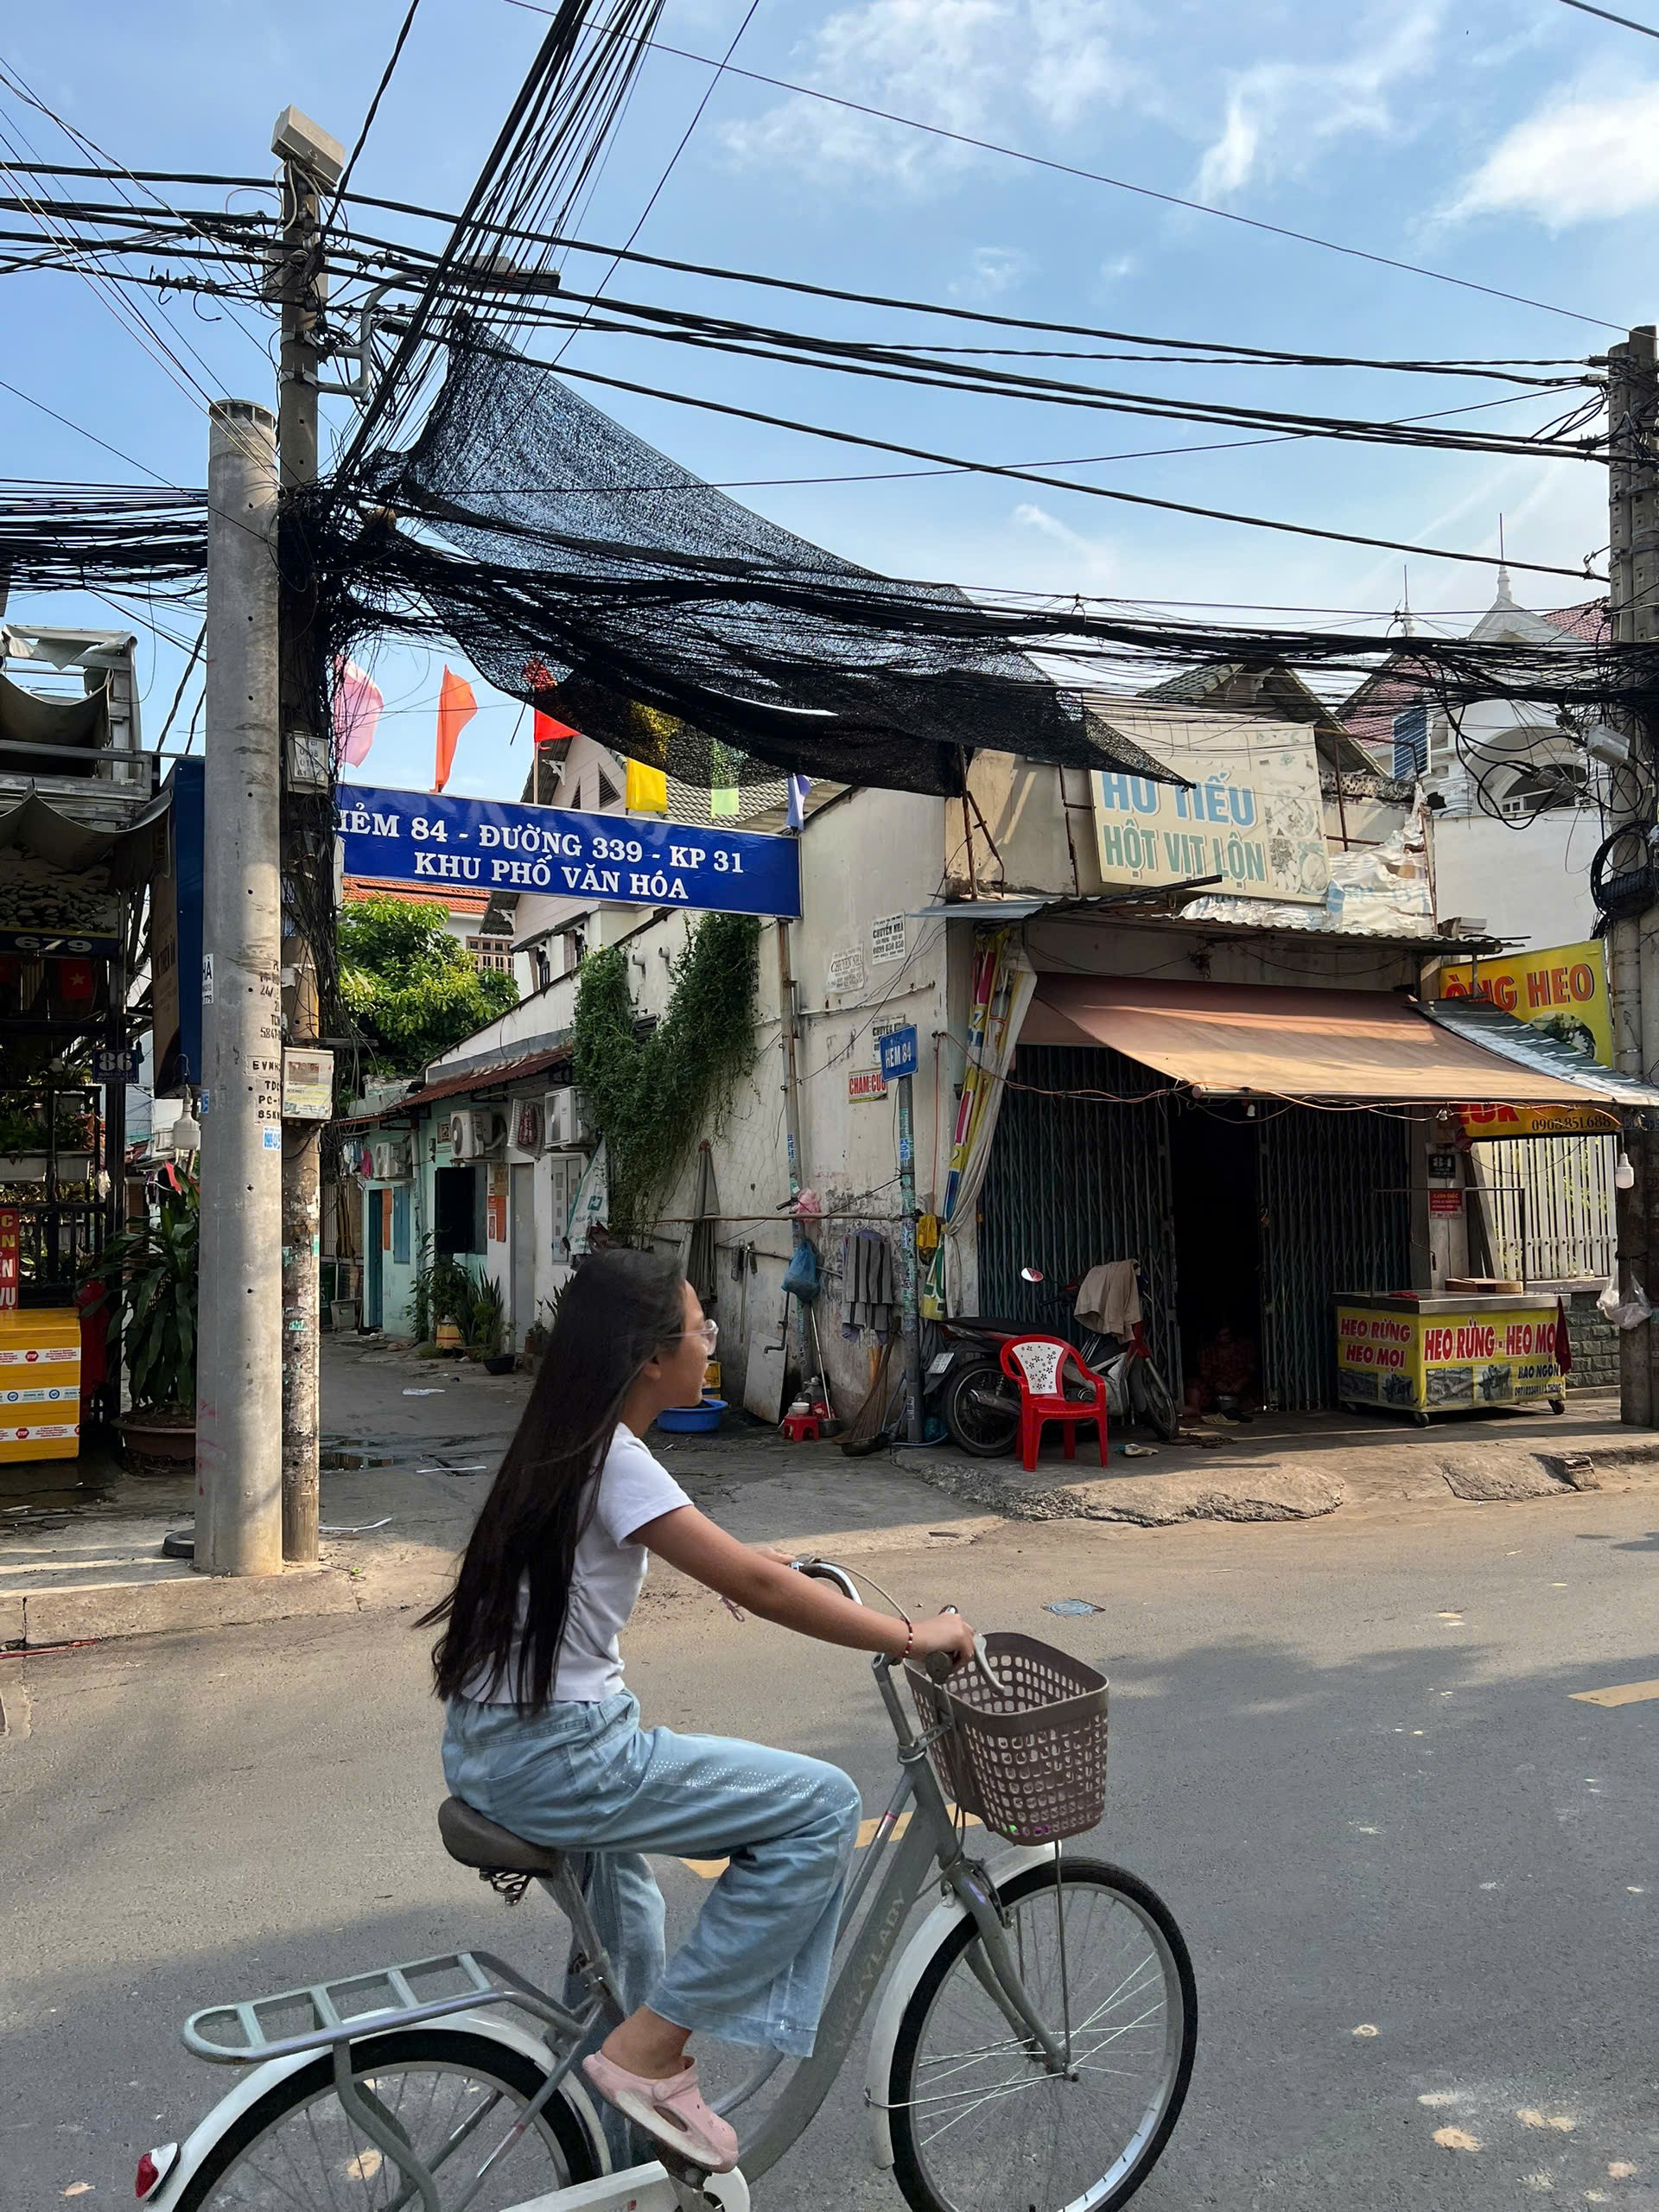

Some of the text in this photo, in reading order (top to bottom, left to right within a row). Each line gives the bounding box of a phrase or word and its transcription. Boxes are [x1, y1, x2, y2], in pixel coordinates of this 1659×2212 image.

[1176, 772, 1254, 826] TIẾU
[410, 817, 448, 842] 84
[479, 823, 582, 857] ĐƯỜNG
[592, 836, 643, 862] 339
[670, 845, 706, 869] KP
[713, 850, 744, 874] 31
[1103, 818, 1266, 889] HỘT VỊT LỘN
[414, 851, 689, 899] KHU PHỐ VĂN HÓA
[1446, 963, 1595, 1012] ÒNG HEO
[99, 1052, 132, 1071] 86
[902, 1042, 912, 1064] 84
[1340, 1318, 1412, 1343] HEO RỪNG
[1423, 1328, 1453, 1361] HEO
[1456, 1319, 1496, 1359] RỪNG
[1506, 1324, 1533, 1356] HEO
[1535, 1322, 1556, 1363] MỌ
[1346, 1344, 1406, 1372] HEO MỌI
[1517, 1365, 1535, 1380] BAO
